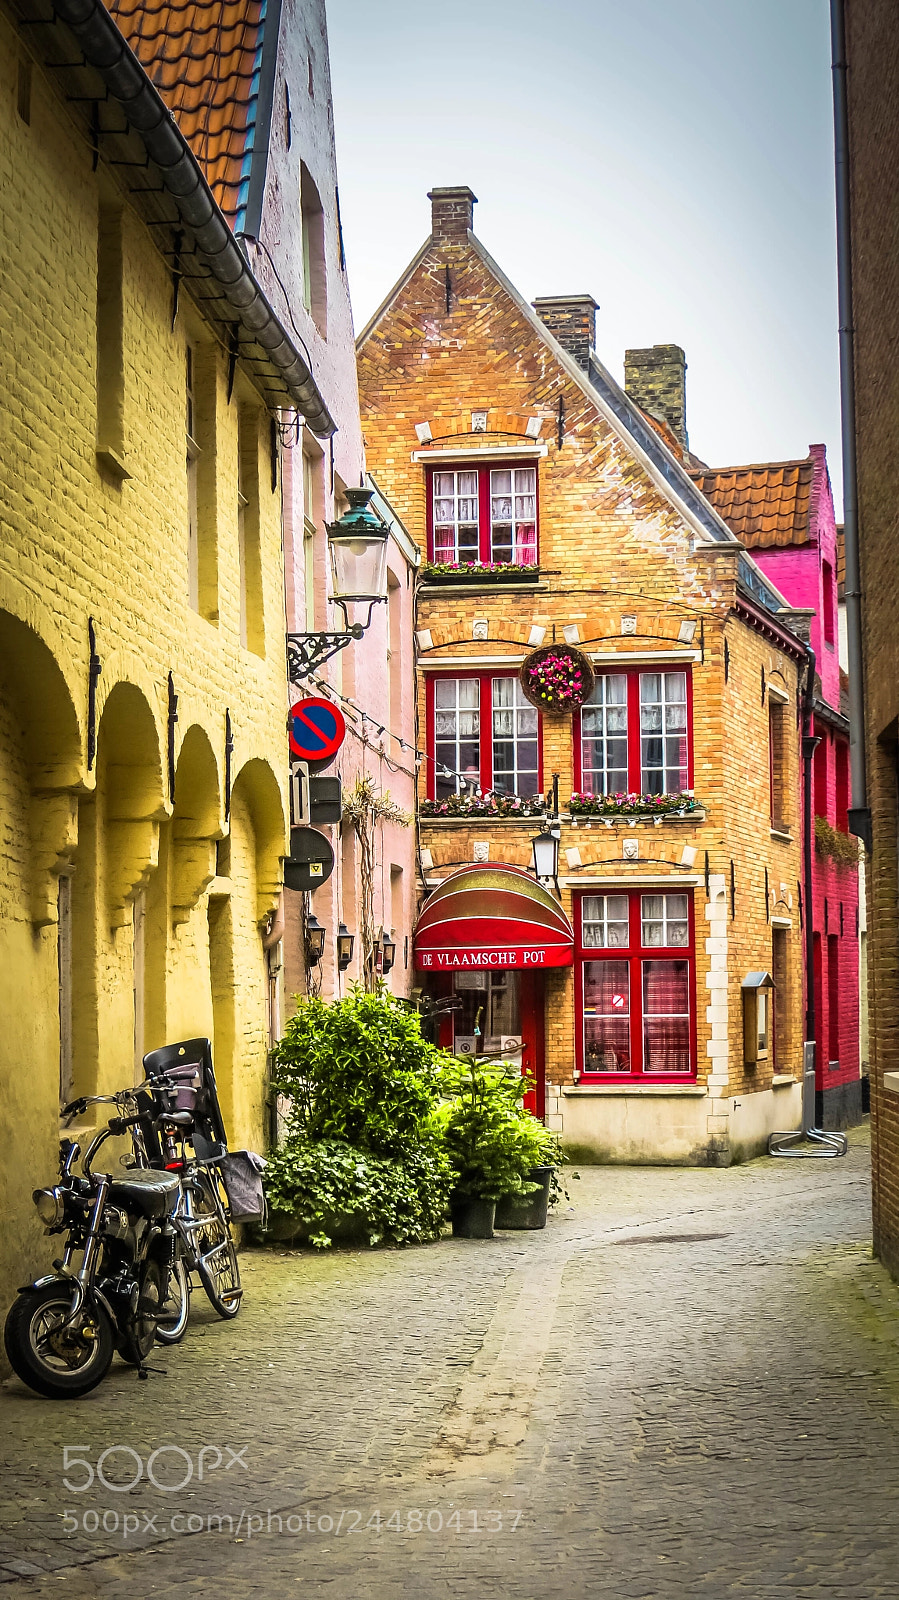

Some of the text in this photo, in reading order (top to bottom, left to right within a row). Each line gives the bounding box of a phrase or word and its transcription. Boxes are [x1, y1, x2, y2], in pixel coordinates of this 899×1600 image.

[422, 950, 546, 966] DE VLAAMSCHE POT
